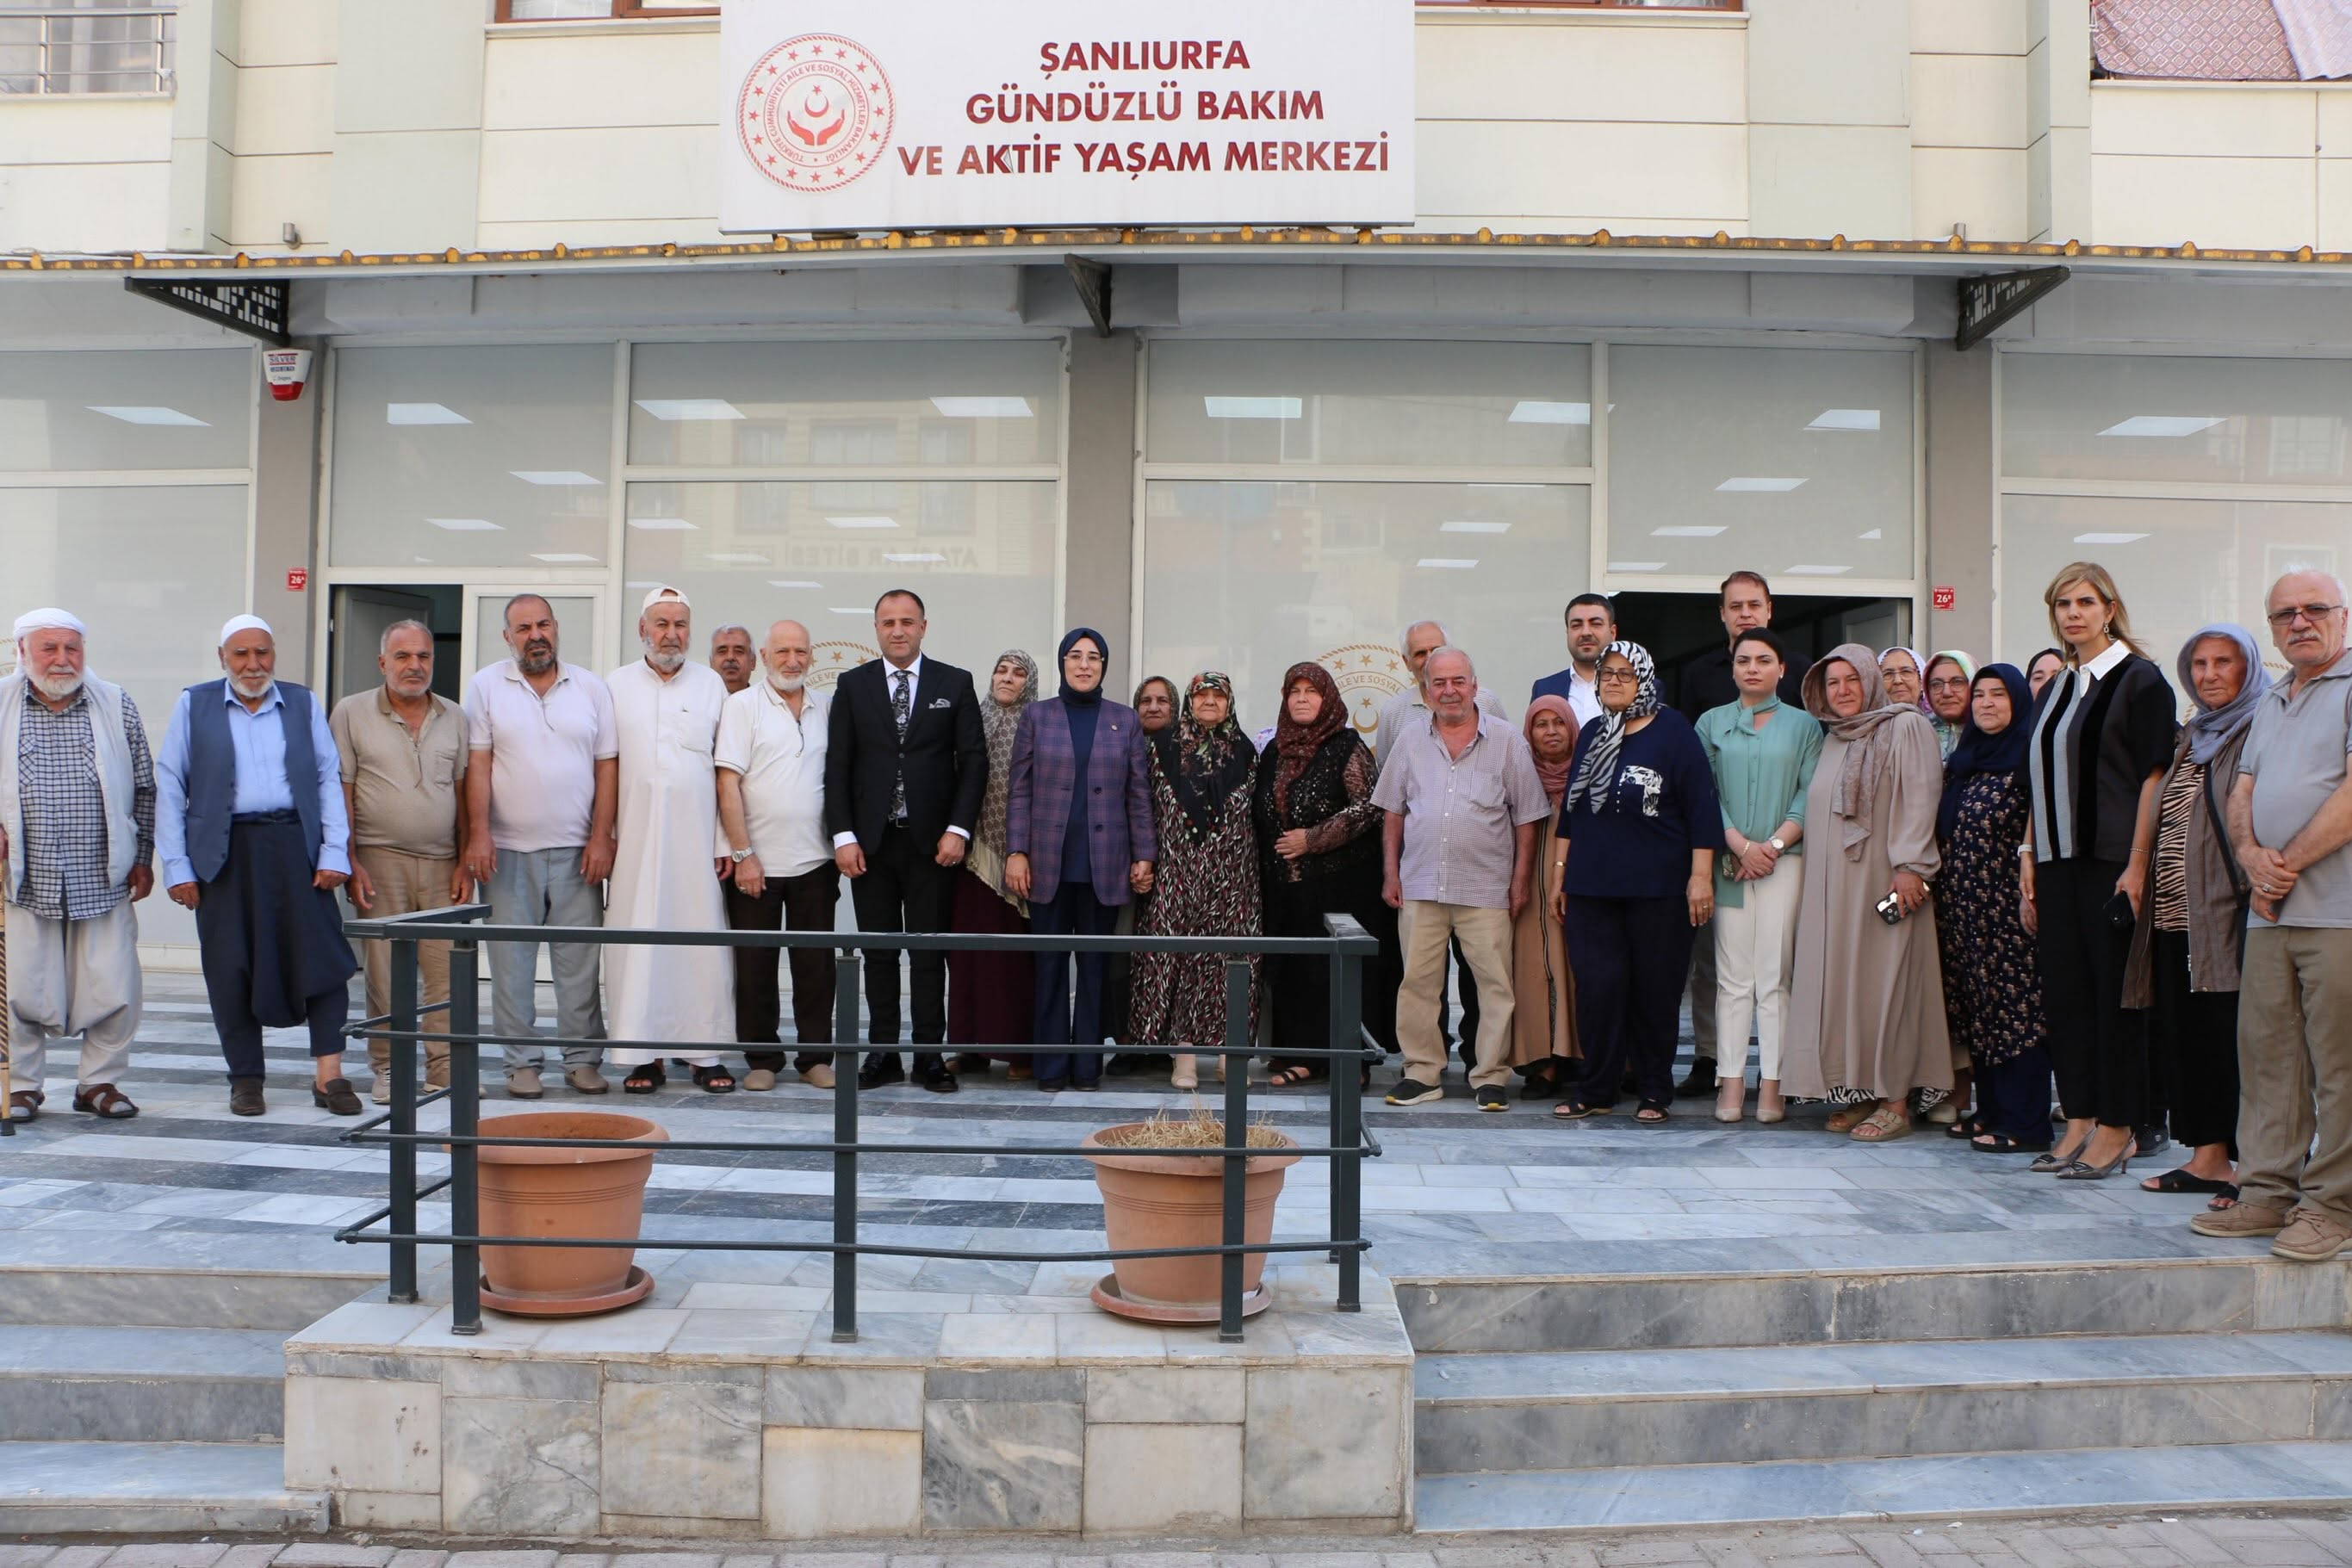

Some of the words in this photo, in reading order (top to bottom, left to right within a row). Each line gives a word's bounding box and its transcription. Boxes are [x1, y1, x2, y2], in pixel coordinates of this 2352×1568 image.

[787, 67, 804, 83] AİLE
[805, 64, 818, 72] VE
[818, 64, 848, 83] SOSYAL
[1039, 40, 1250, 79] ŞANLIURFA
[766, 78, 788, 136] CUMHURİYETİ
[847, 78, 866, 126] HİZMETLER
[965, 81, 1181, 124] GÜNDÜZLÜ
[1198, 91, 1323, 121] BAKIM
[775, 137, 804, 162] TÜRKİYE
[826, 125, 866, 163] BAKANLIĞI
[898, 146, 941, 176] VE
[957, 133, 1061, 174] AKTİF
[1074, 142, 1211, 181] YAŞAM
[1224, 131, 1388, 171] MERKEZİ
[1368, 676, 1401, 695] SOSYAL
